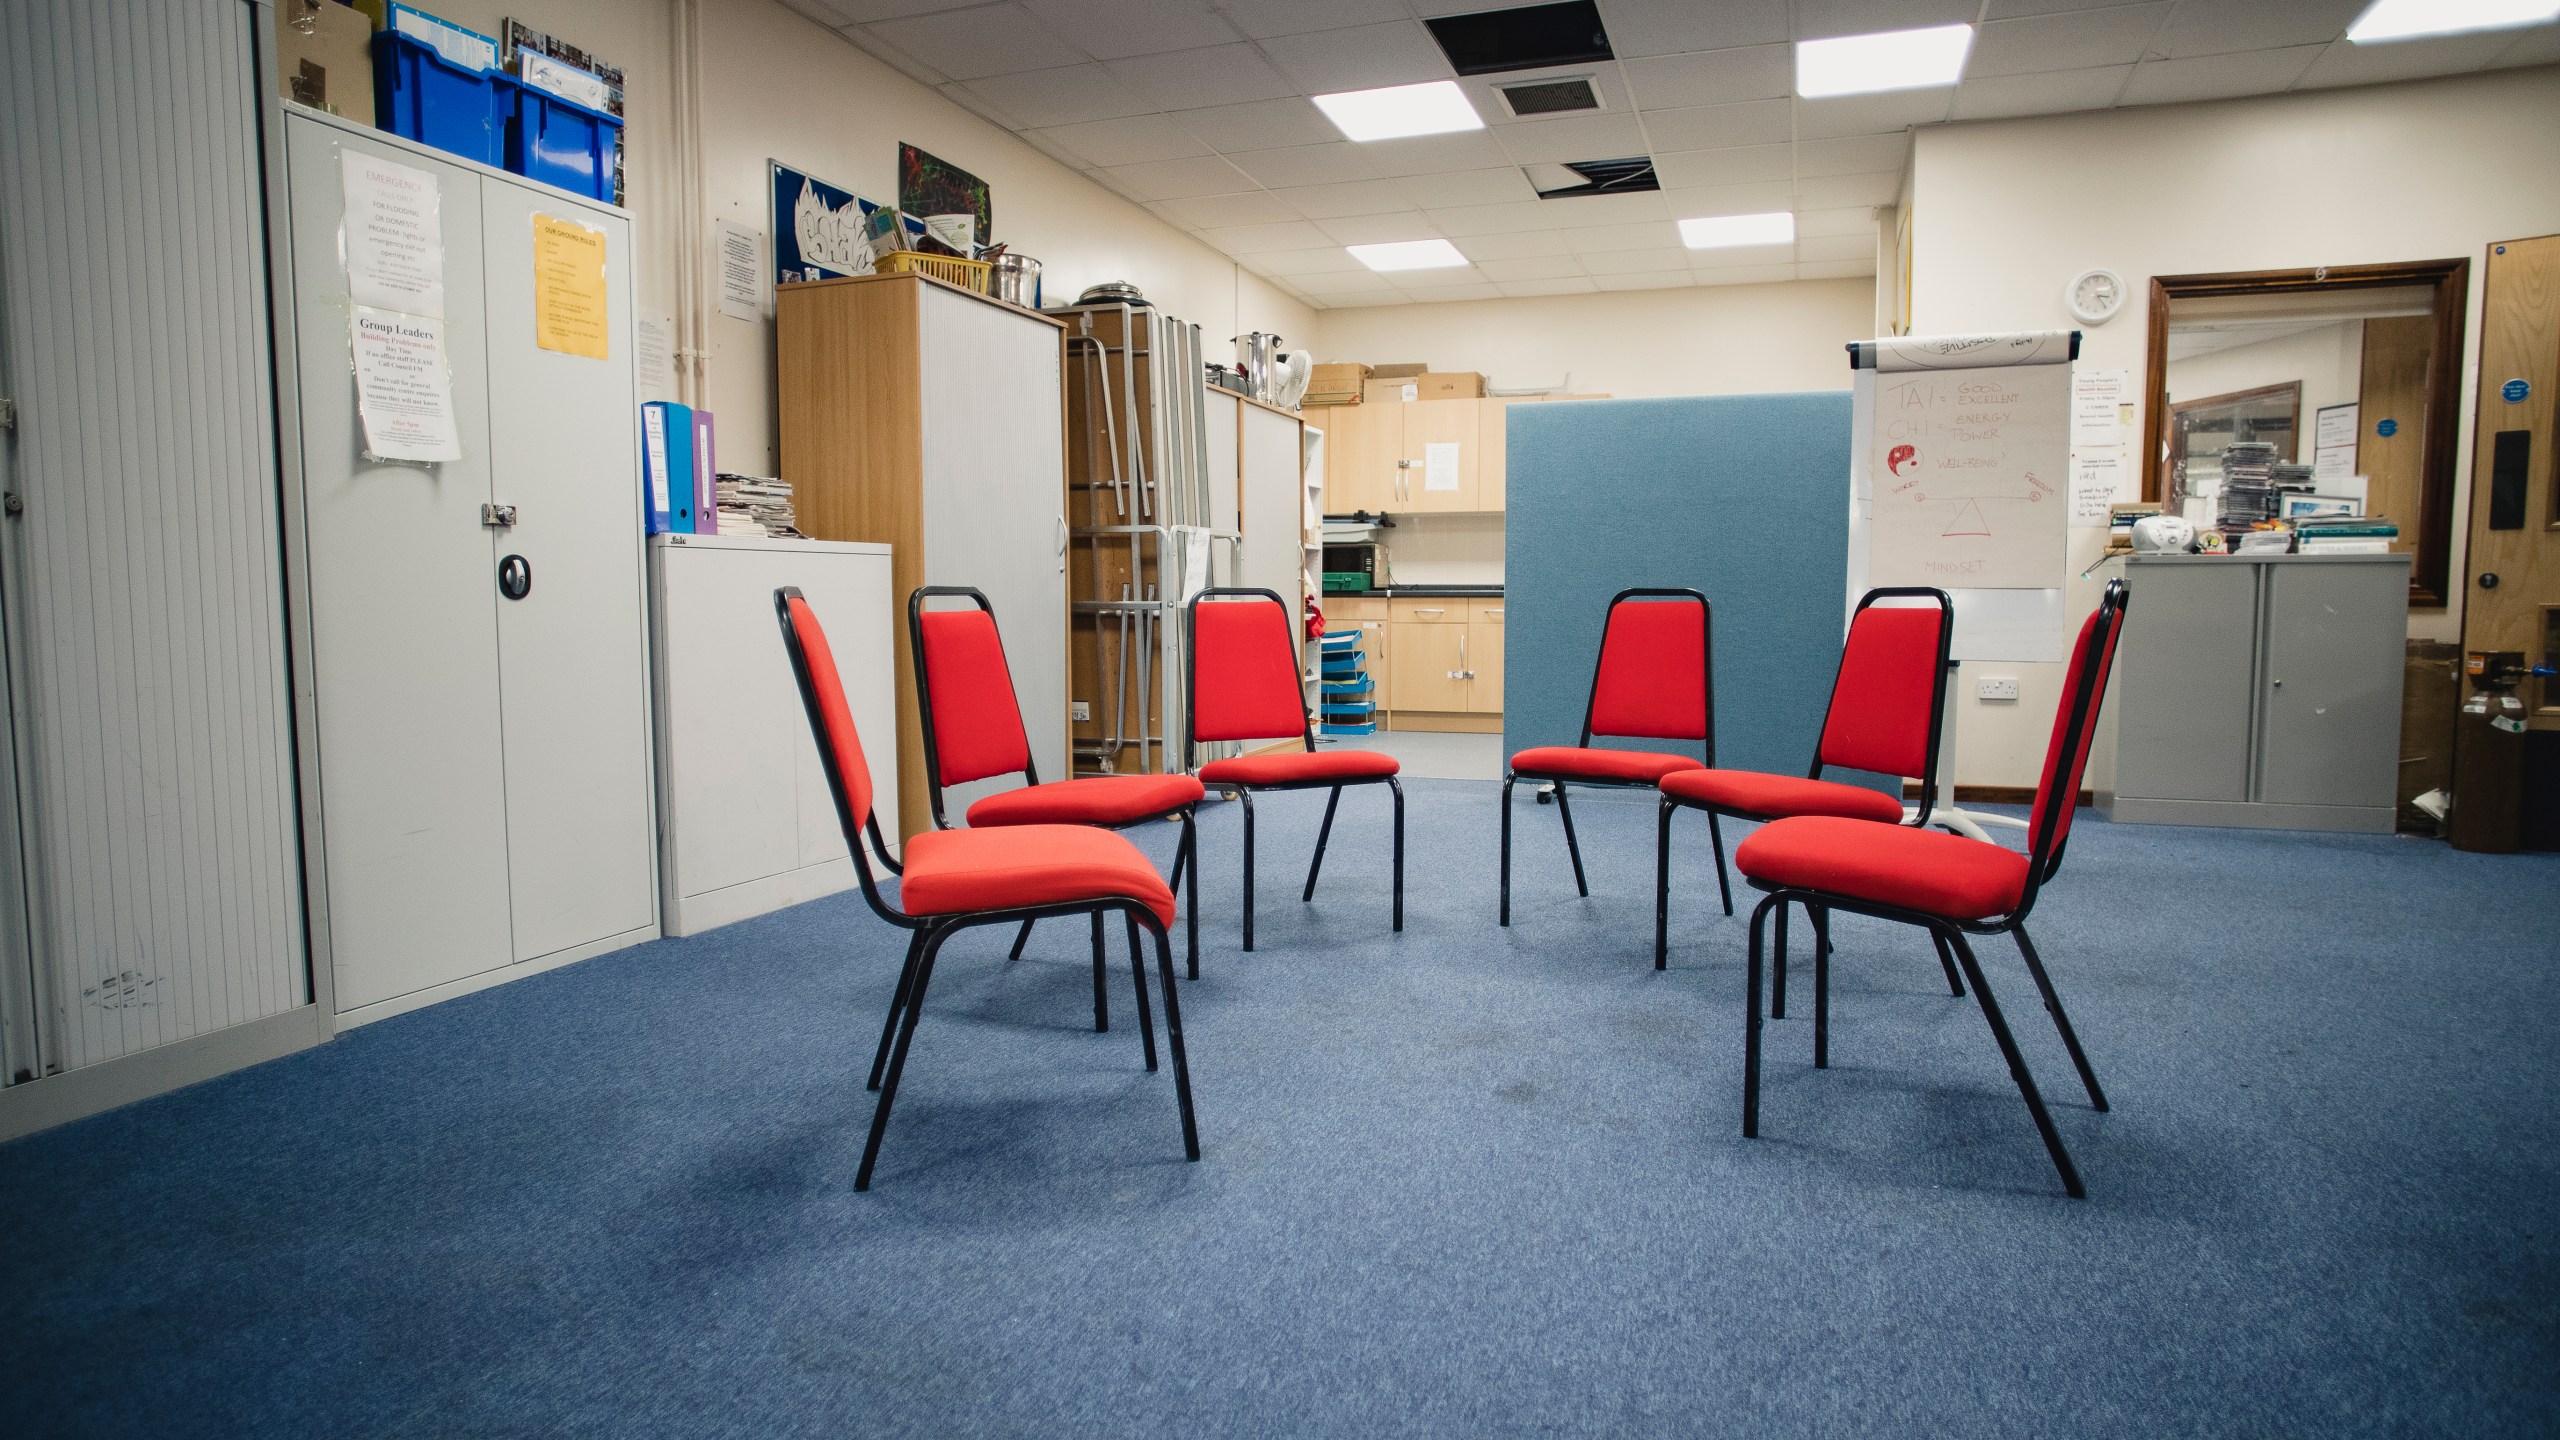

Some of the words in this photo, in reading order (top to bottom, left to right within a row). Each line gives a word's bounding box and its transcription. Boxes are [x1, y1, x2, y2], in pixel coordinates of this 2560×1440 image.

[366, 170, 421, 193] EMERGENCY
[397, 194, 414, 203] ONLY
[373, 200, 385, 210] FOR
[386, 204, 420, 217] FLOODING
[385, 216, 419, 230] DOMESTIC
[368, 237, 404, 249] emergency
[544, 226, 558, 236] OUR
[557, 230, 579, 242] GROUND
[579, 236, 597, 247] RULES
[360, 318, 393, 335] Group
[396, 324, 434, 340] Leaders
[360, 331, 390, 344] Building
[391, 337, 421, 349] Problems
[422, 343, 437, 352] only
[385, 345, 397, 353] Day
[378, 360, 390, 368] Call
[391, 362, 412, 371] Council
[380, 353, 395, 361] office
[397, 355, 409, 363] staff
[410, 357, 433, 366] PLEASE
[366, 384, 397, 393] community
[373, 375, 389, 383] Don't
[410, 381, 431, 390] general
[1958, 382, 2003, 394] GOOD
[366, 391, 387, 400] because
[388, 395, 400, 404] they
[1886, 379, 1934, 409] TAI
[1958, 394, 2020, 405] EXCELLENT
[650, 411, 656, 419] 7
[1955, 412, 2011, 426] ENERGY
[392, 419, 405, 427] After
[1887, 419, 1928, 440] CHI
[1951, 428, 2000, 442] POWER
[1891, 480, 1920, 495] WORRY
[2024, 471, 2055, 496] FREEDOM
